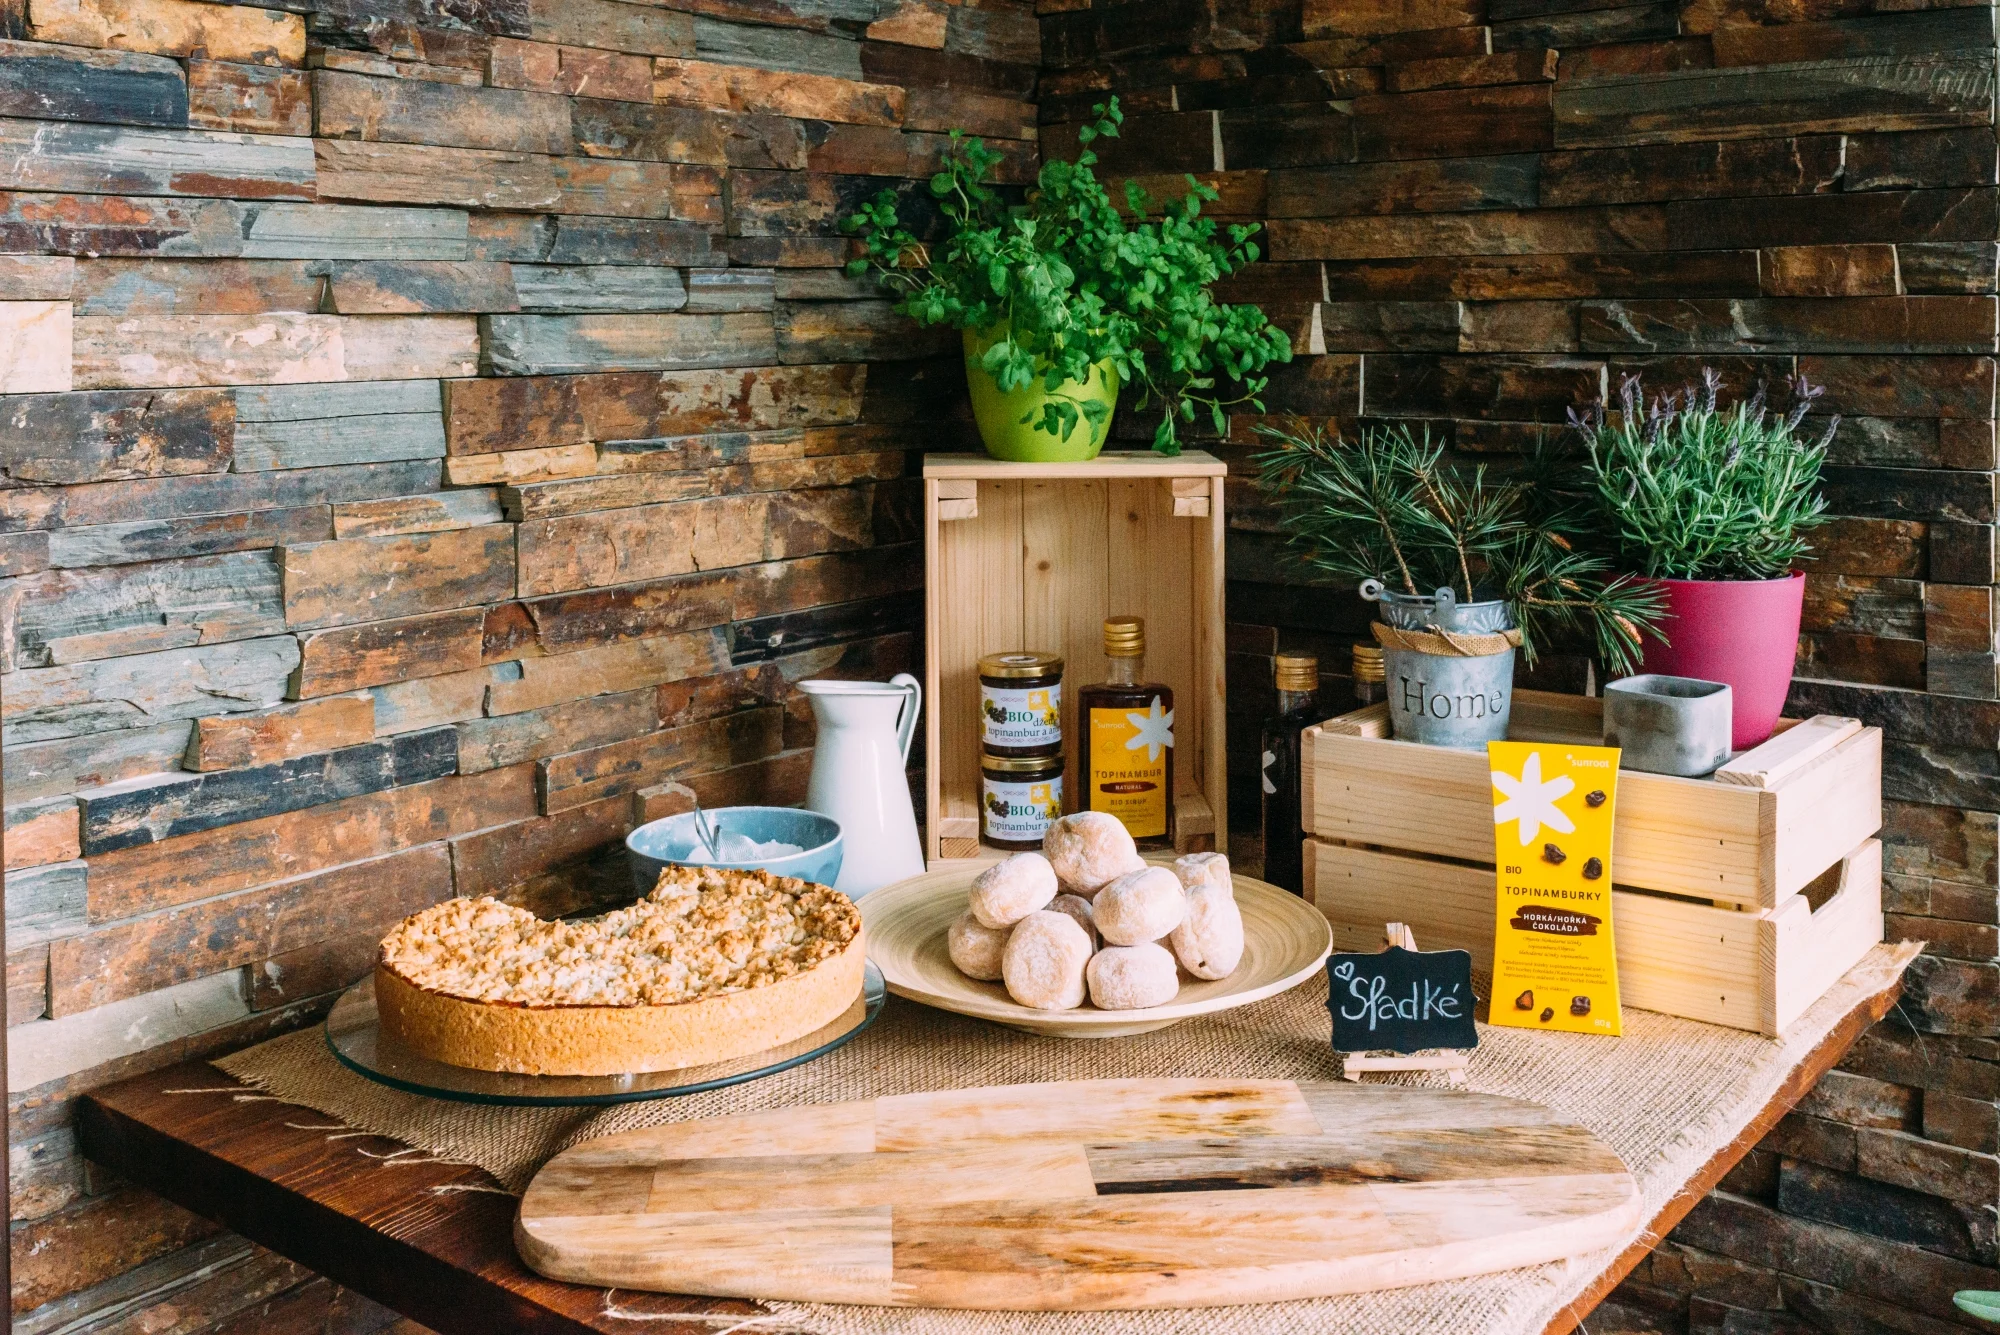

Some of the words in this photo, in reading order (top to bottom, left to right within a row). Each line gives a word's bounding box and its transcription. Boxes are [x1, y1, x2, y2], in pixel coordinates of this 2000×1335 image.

[1401, 676, 1503, 719] Home
[1008, 711, 1033, 722] BIO
[988, 727, 1039, 739] topinambur
[1571, 759, 1609, 768] sunroot
[1094, 768, 1162, 779] TOPINAMBUR
[1125, 798, 1147, 806] SIRUP
[1010, 805, 1035, 816] BIO
[989, 820, 1042, 832] topinambur
[1044, 822, 1049, 830] a
[1505, 865, 1522, 875] BIO
[1505, 886, 1602, 901] TOPINAMBURKY
[1523, 913, 1587, 924] HORKÁ/HOŘKÁ
[1532, 922, 1579, 932] ČOKOLÁDA
[1341, 975, 1463, 1031] Sladké
